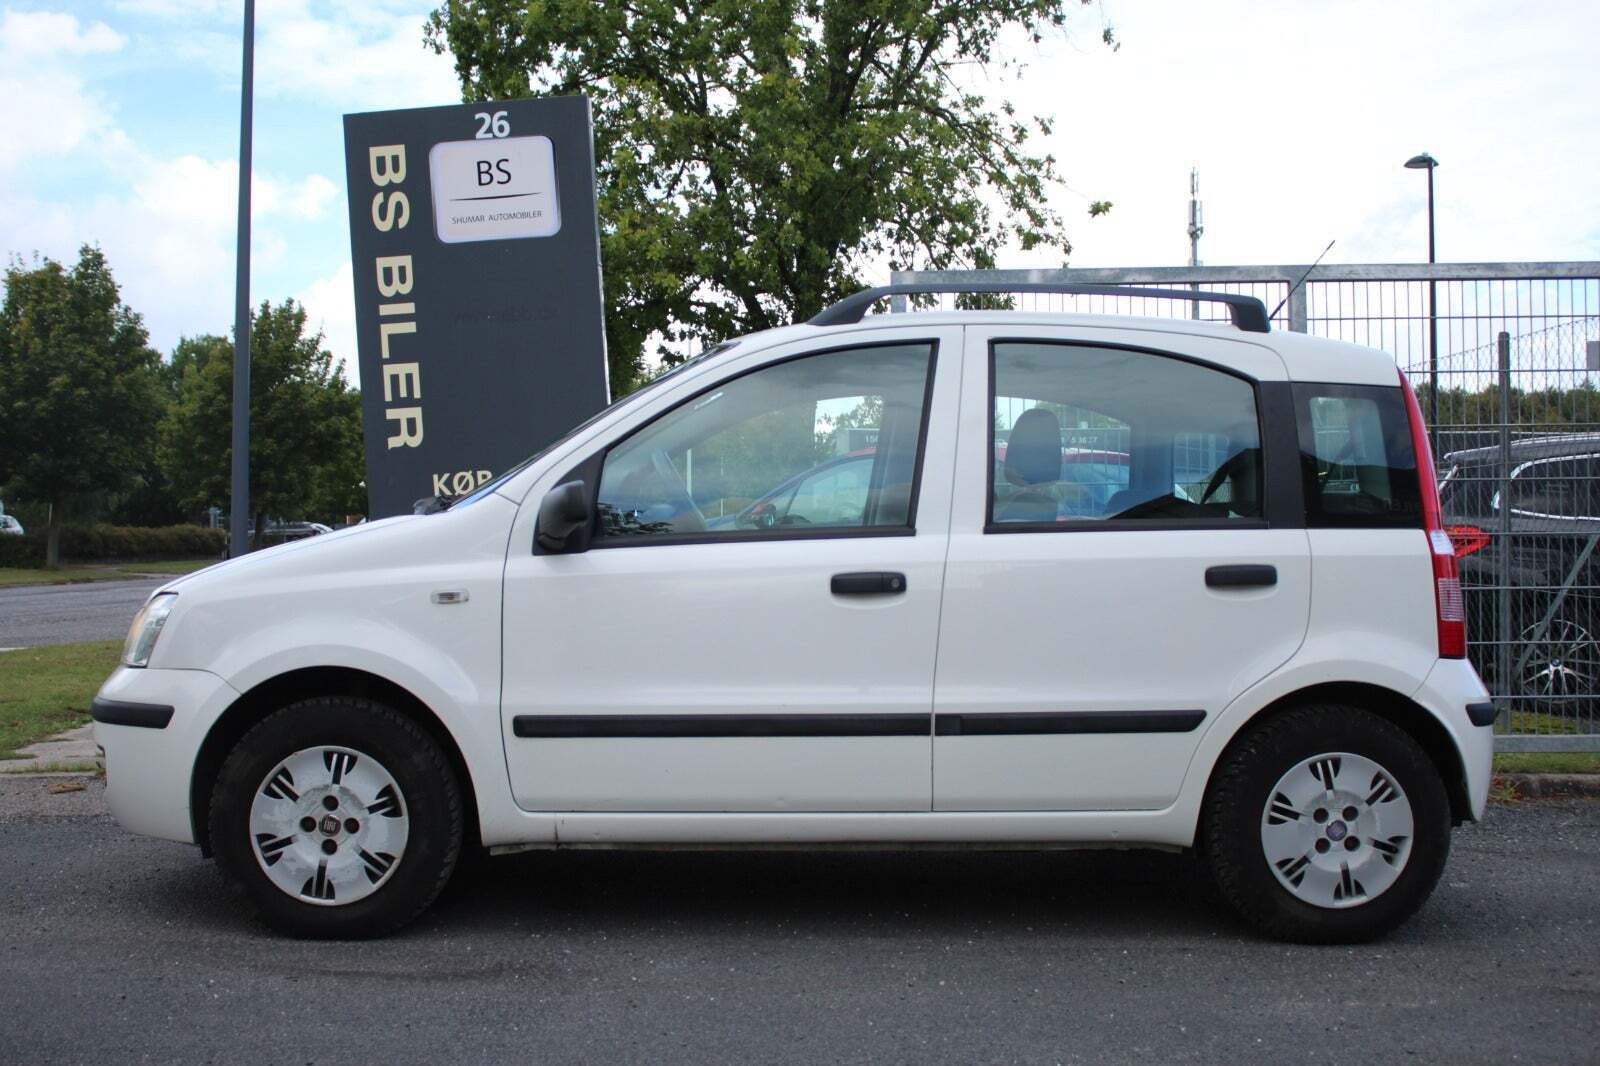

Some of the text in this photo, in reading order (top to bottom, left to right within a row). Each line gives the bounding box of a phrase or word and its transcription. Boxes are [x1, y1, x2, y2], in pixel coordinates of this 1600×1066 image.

[474, 111, 511, 140] 26
[476, 158, 512, 187] BS
[451, 210, 543, 225] SHUMAR AUTOMOBILER
[369, 144, 424, 450] BS BILER
